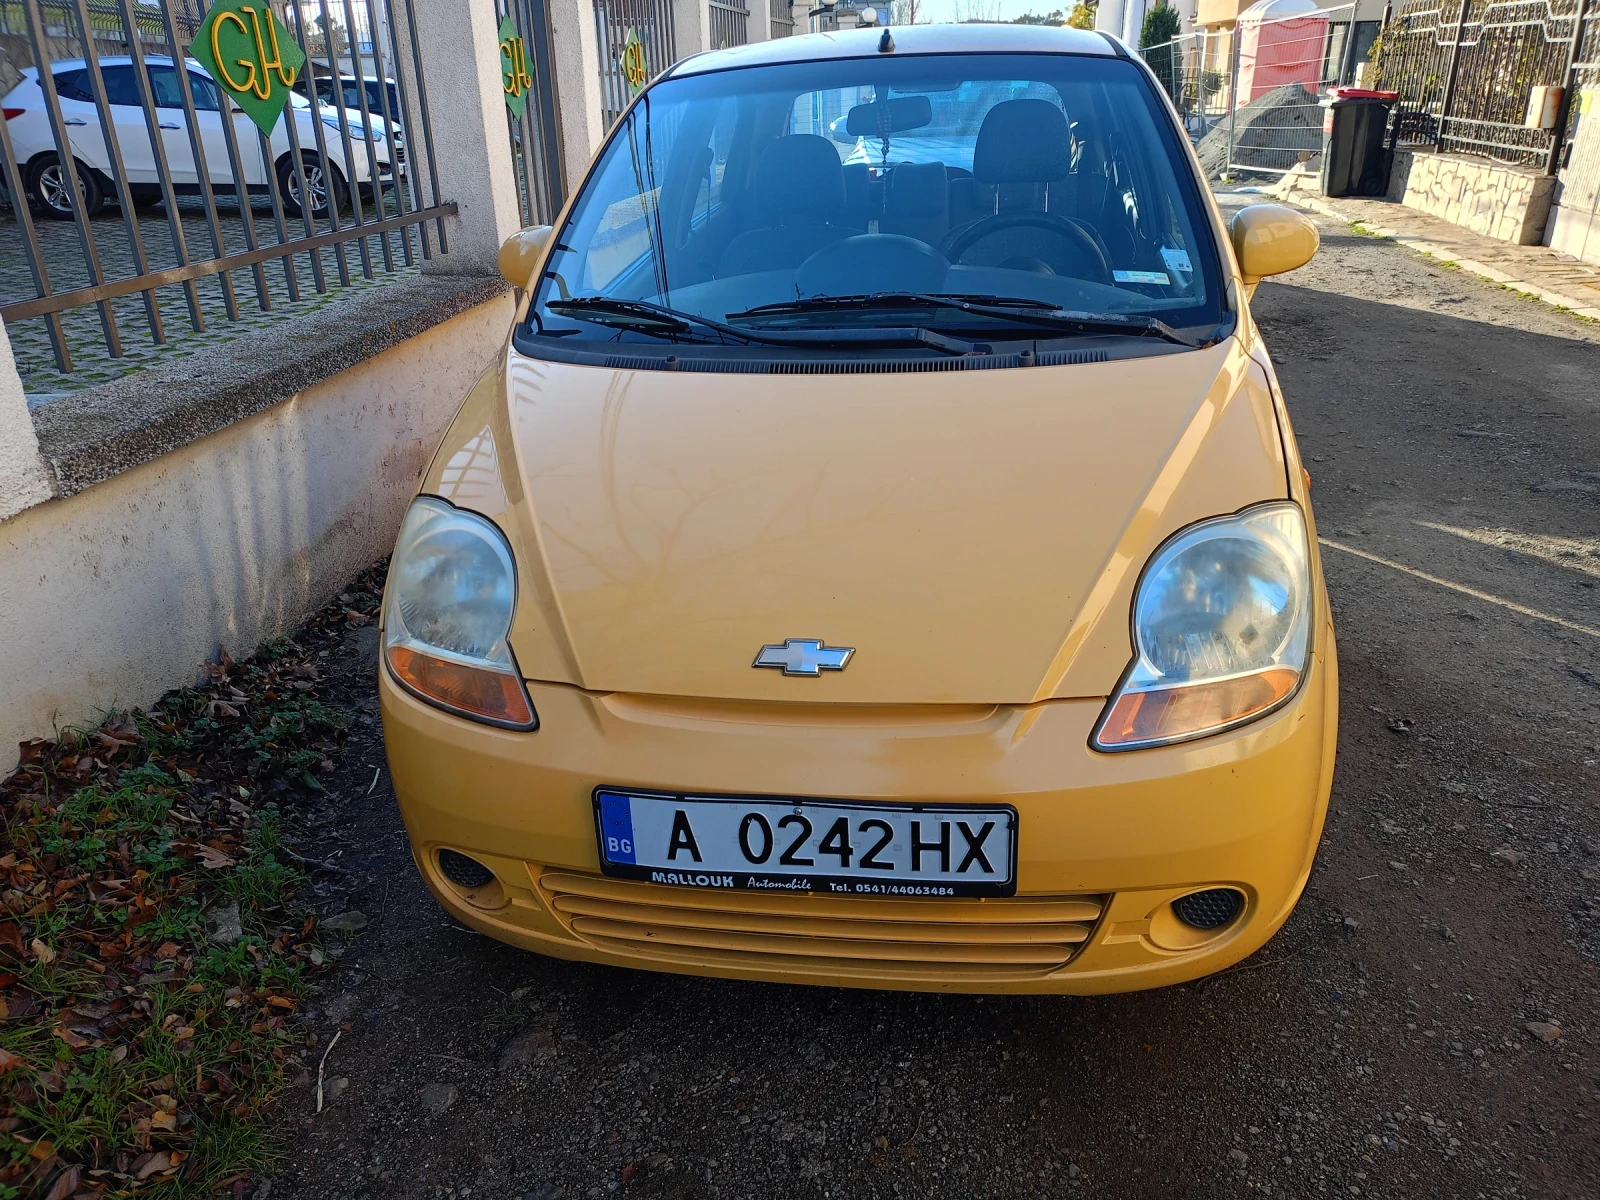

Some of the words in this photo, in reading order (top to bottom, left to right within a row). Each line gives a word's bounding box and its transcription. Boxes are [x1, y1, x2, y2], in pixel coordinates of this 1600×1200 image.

[211, 6, 295, 100] GH
[499, 37, 532, 97] GH
[607, 837, 632, 854] BG
[667, 809, 704, 863] A
[738, 812, 895, 871] 0242
[910, 820, 996, 873] HX
[652, 871, 734, 888] MALLOUK
[747, 876, 812, 890] Automobile
[829, 882, 852, 892] Tel.
[855, 883, 955, 896] 0541/44063484
